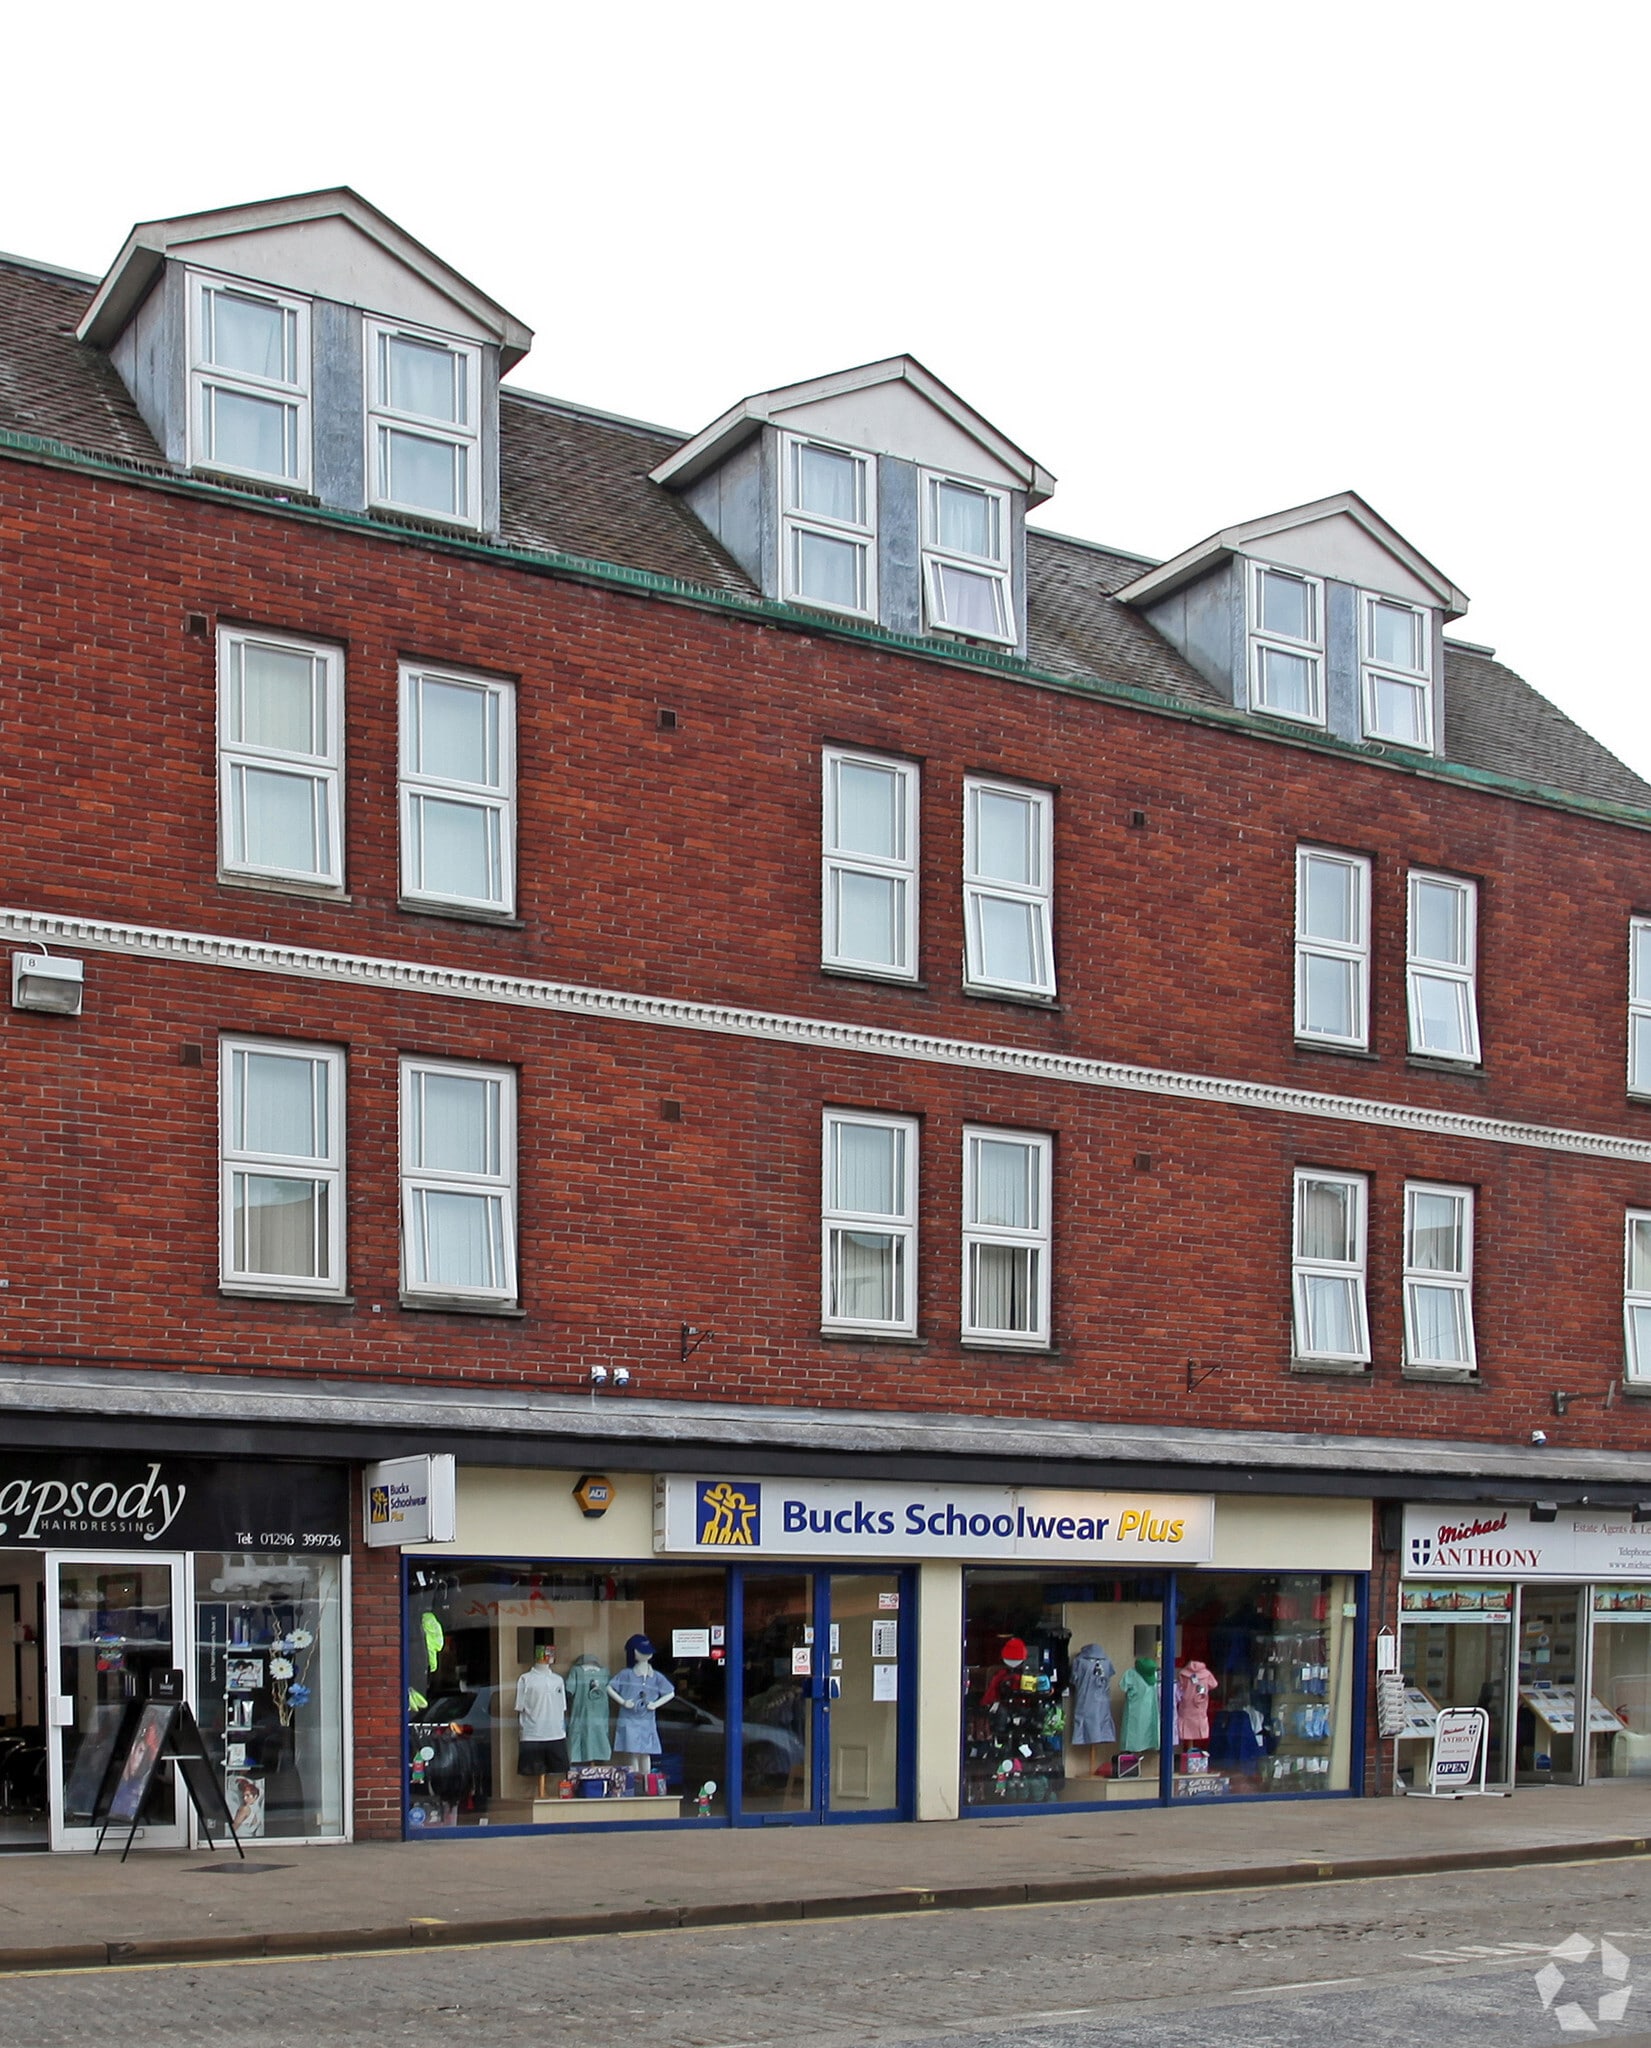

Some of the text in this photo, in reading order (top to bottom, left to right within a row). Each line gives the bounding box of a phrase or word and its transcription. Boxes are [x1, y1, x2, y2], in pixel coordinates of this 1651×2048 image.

[390, 1483, 409, 1495] Bucks
[589, 1488, 607, 1498] ADT
[0, 1463, 186, 1541] apsody
[391, 1495, 427, 1509] Schoolwear
[41, 1520, 155, 1532] HAIRDRESSING
[783, 1501, 1186, 1542] Bucks Schoolwear Plus
[1438, 1512, 1507, 1545] Michael
[1573, 1522, 1597, 1533] Estate
[1600, 1523, 1627, 1536] Agents
[1629, 1525, 1637, 1534] &
[260, 1533, 295, 1546] 01296
[302, 1534, 342, 1547] 399736
[1432, 1548, 1542, 1567] ANTHONY
[1437, 1762, 1468, 1773] OPEN
